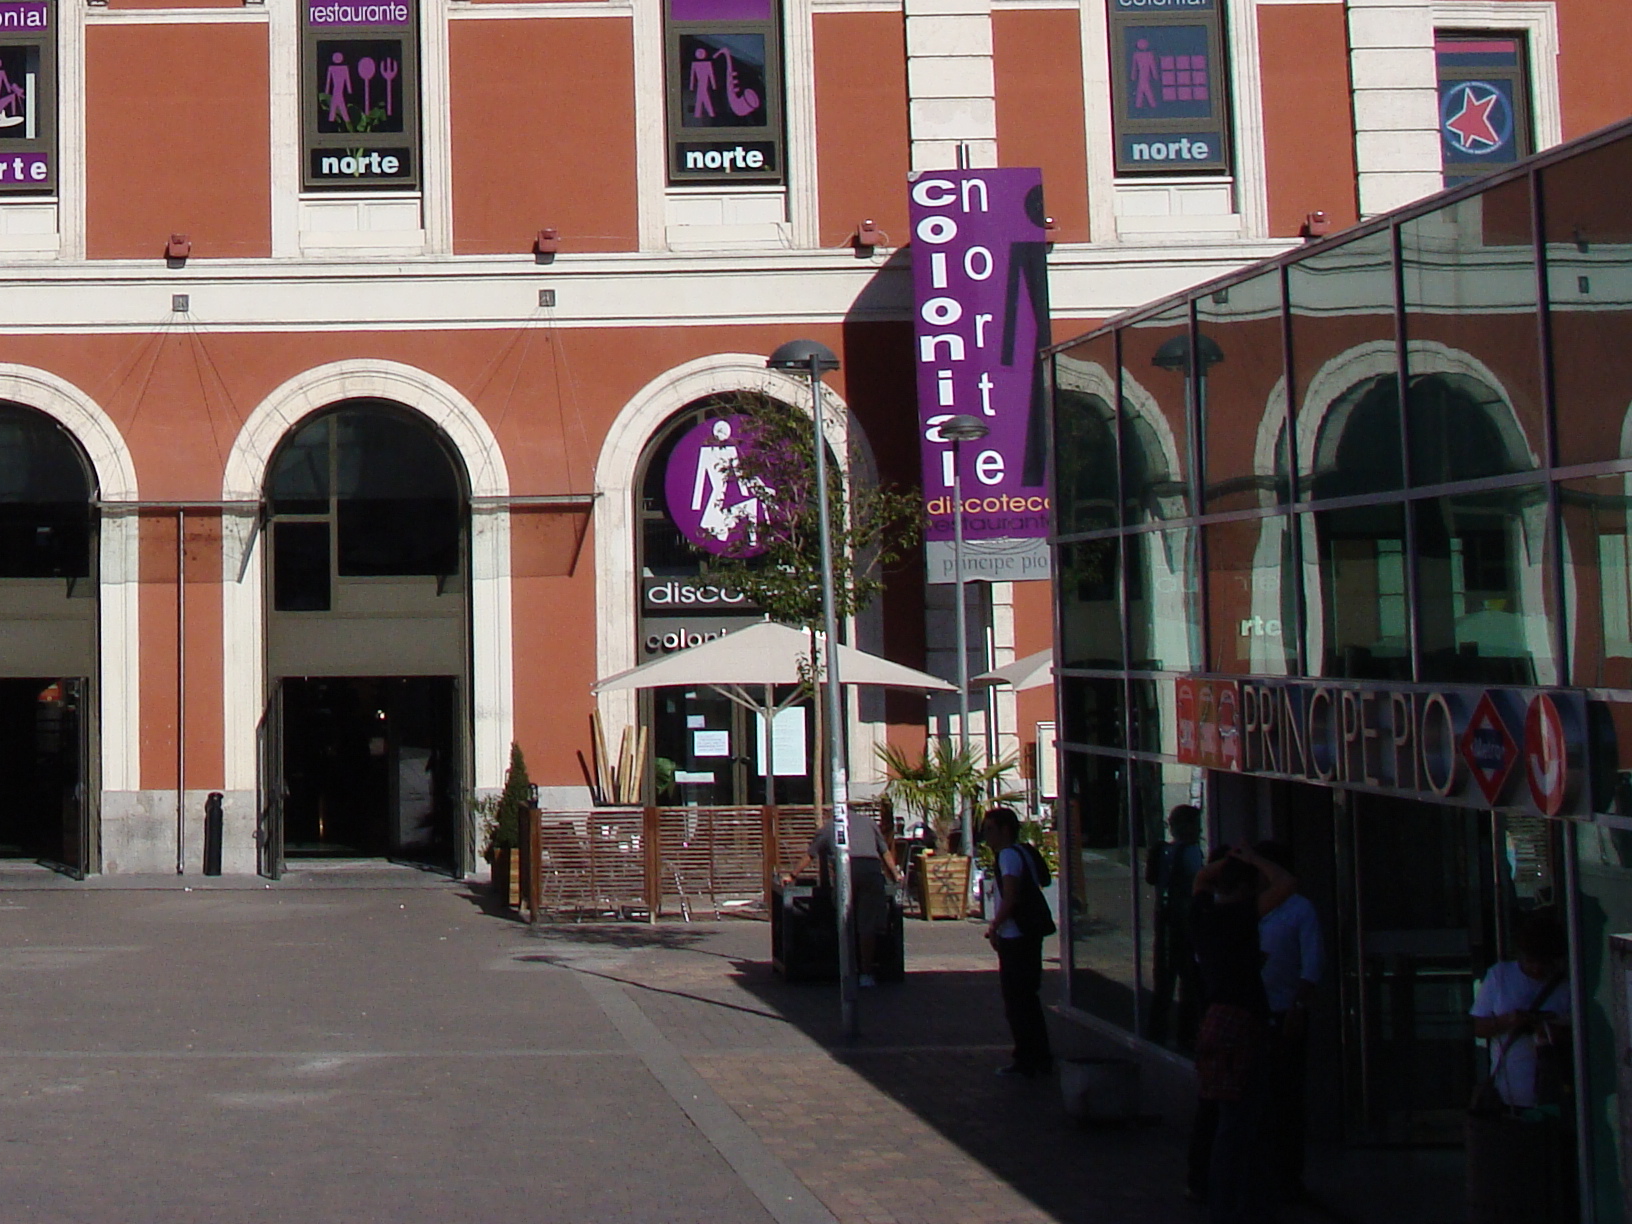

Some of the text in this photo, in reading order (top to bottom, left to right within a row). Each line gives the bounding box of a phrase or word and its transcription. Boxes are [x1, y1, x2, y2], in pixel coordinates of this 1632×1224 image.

[310, 2, 408, 22] restaurante
[686, 146, 763, 168] norte
[1132, 138, 1208, 160] norte
[322, 152, 399, 174] norte
[911, 178, 966, 487] colonial
[960, 177, 1005, 486] norte
[927, 514, 1049, 532] etaurant
[1242, 684, 1380, 787] PRINCIPE
[1391, 691, 1456, 797] PIO
